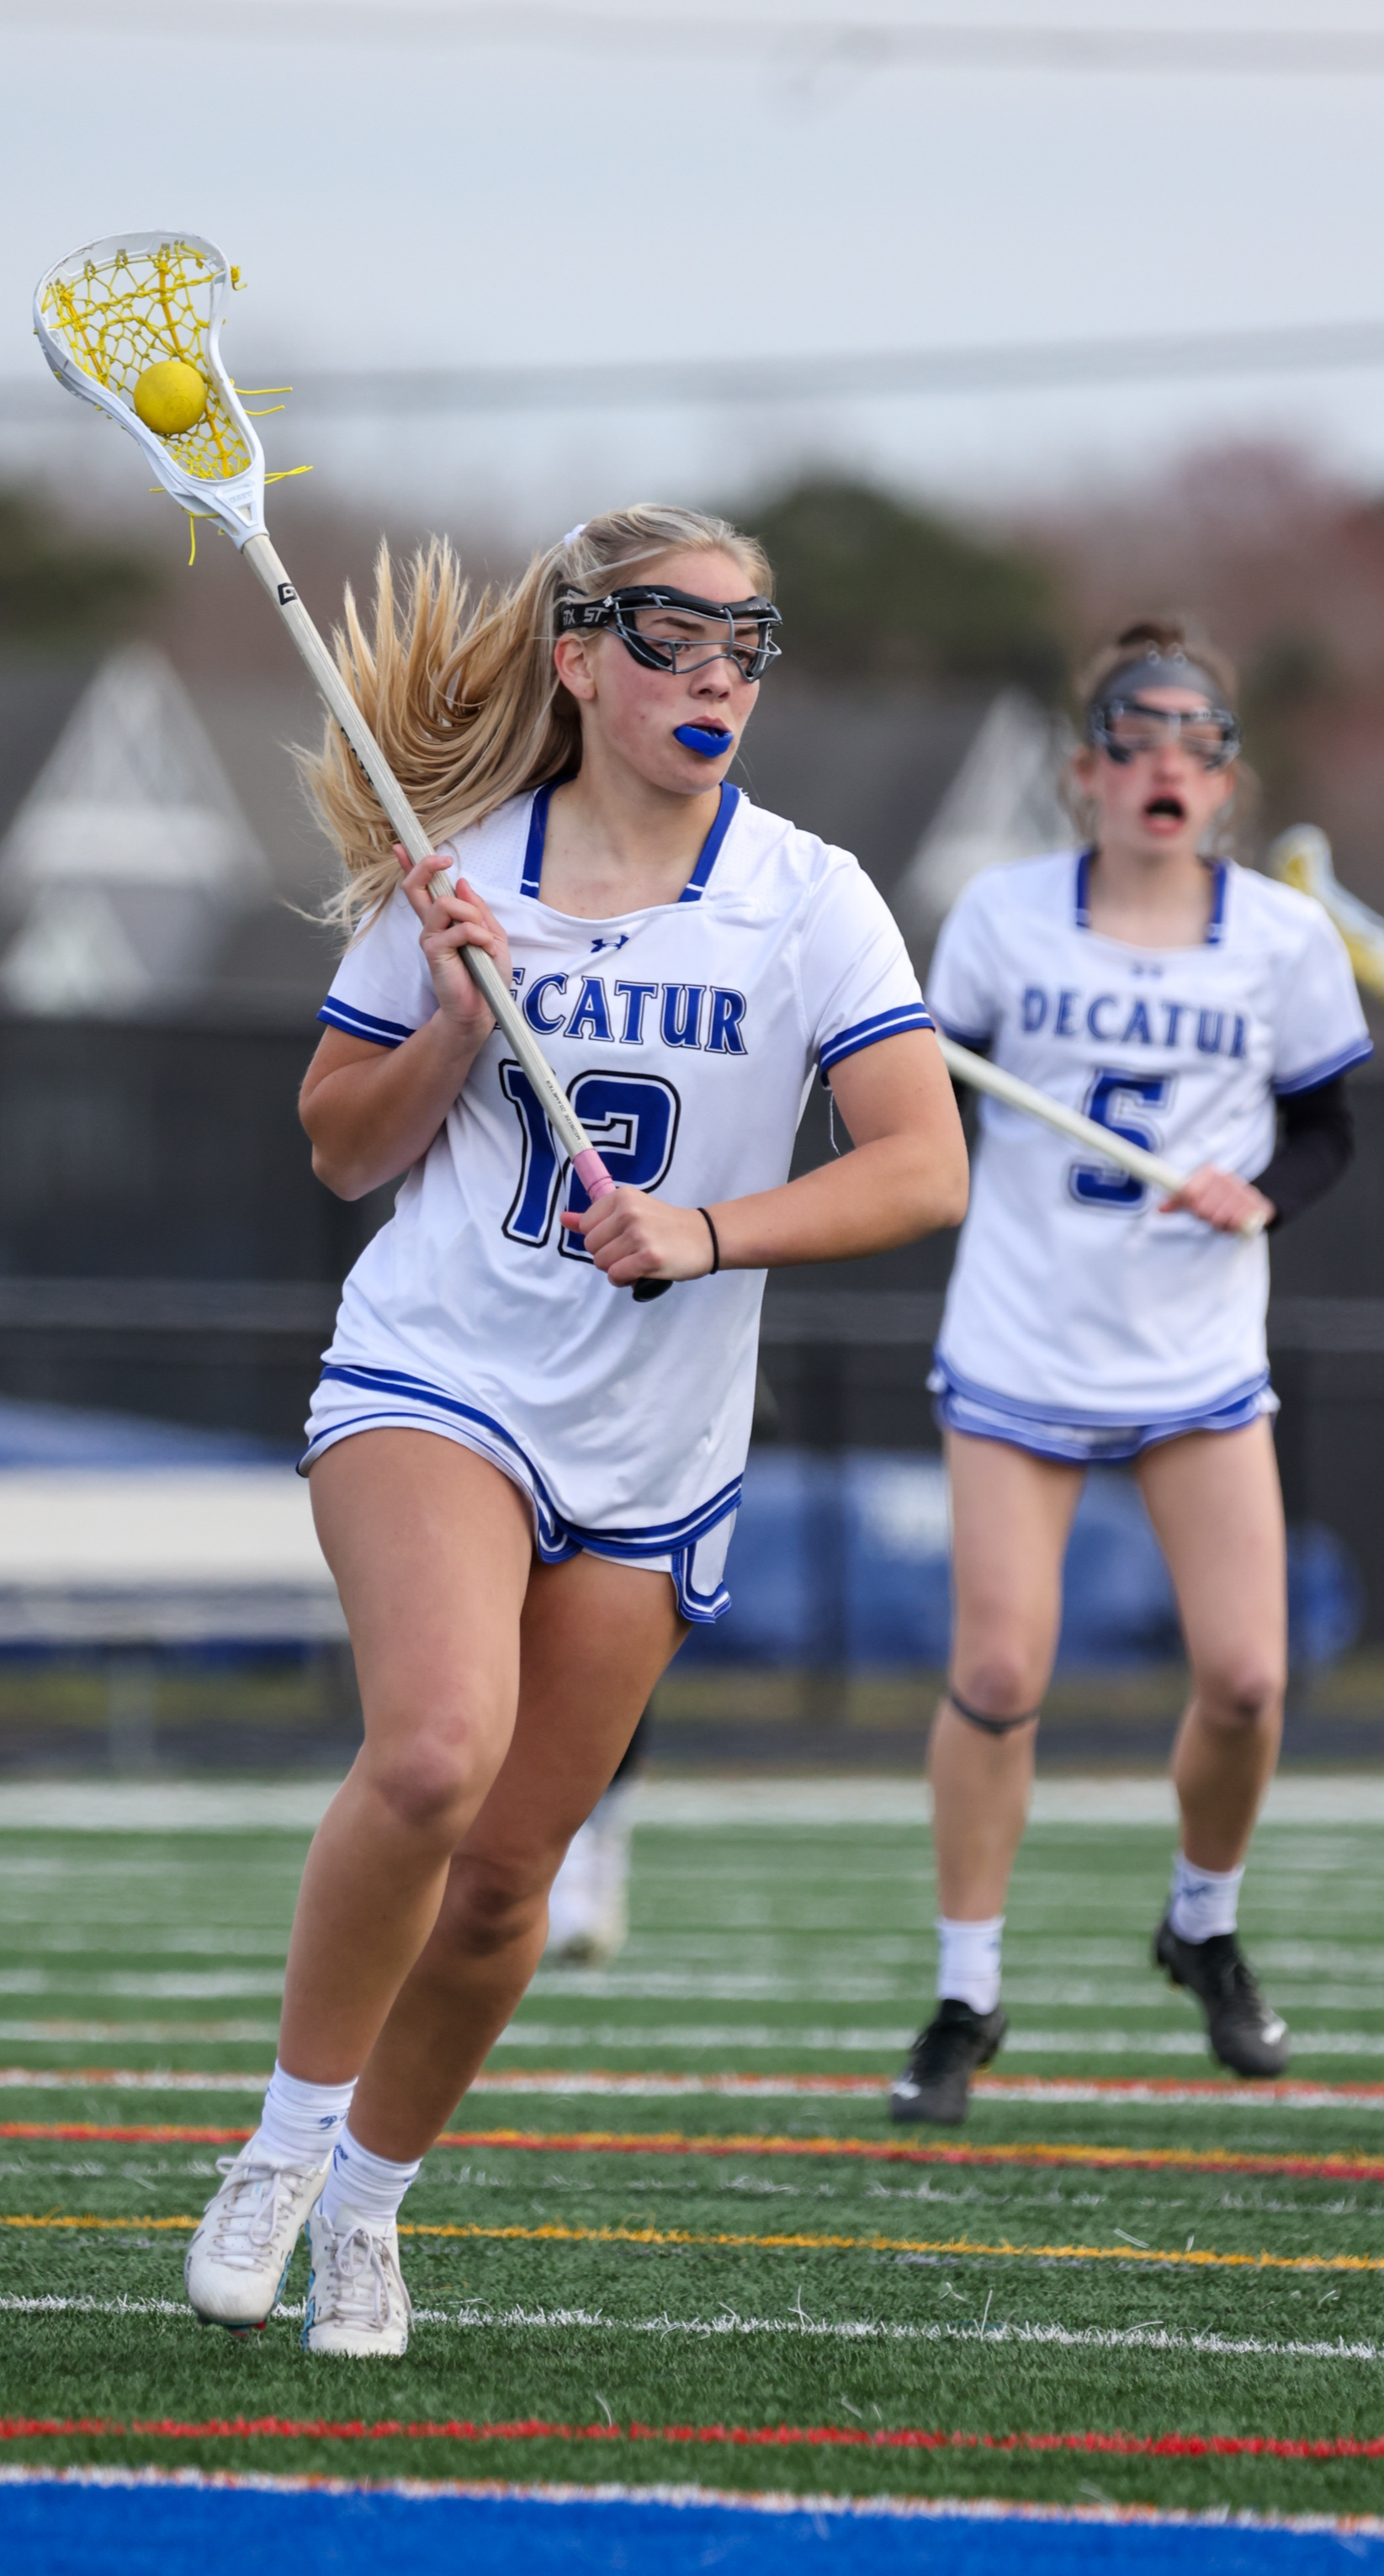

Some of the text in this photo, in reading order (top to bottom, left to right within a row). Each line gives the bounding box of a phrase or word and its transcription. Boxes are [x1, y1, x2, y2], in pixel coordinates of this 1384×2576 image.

[583, 607, 610, 623] ST
[494, 967, 748, 1056] CATUR
[546, 1080, 581, 1140] MIDSIZE DIAMETER
[1068, 1066, 1180, 1215] 5
[498, 1058, 681, 1265] 12
